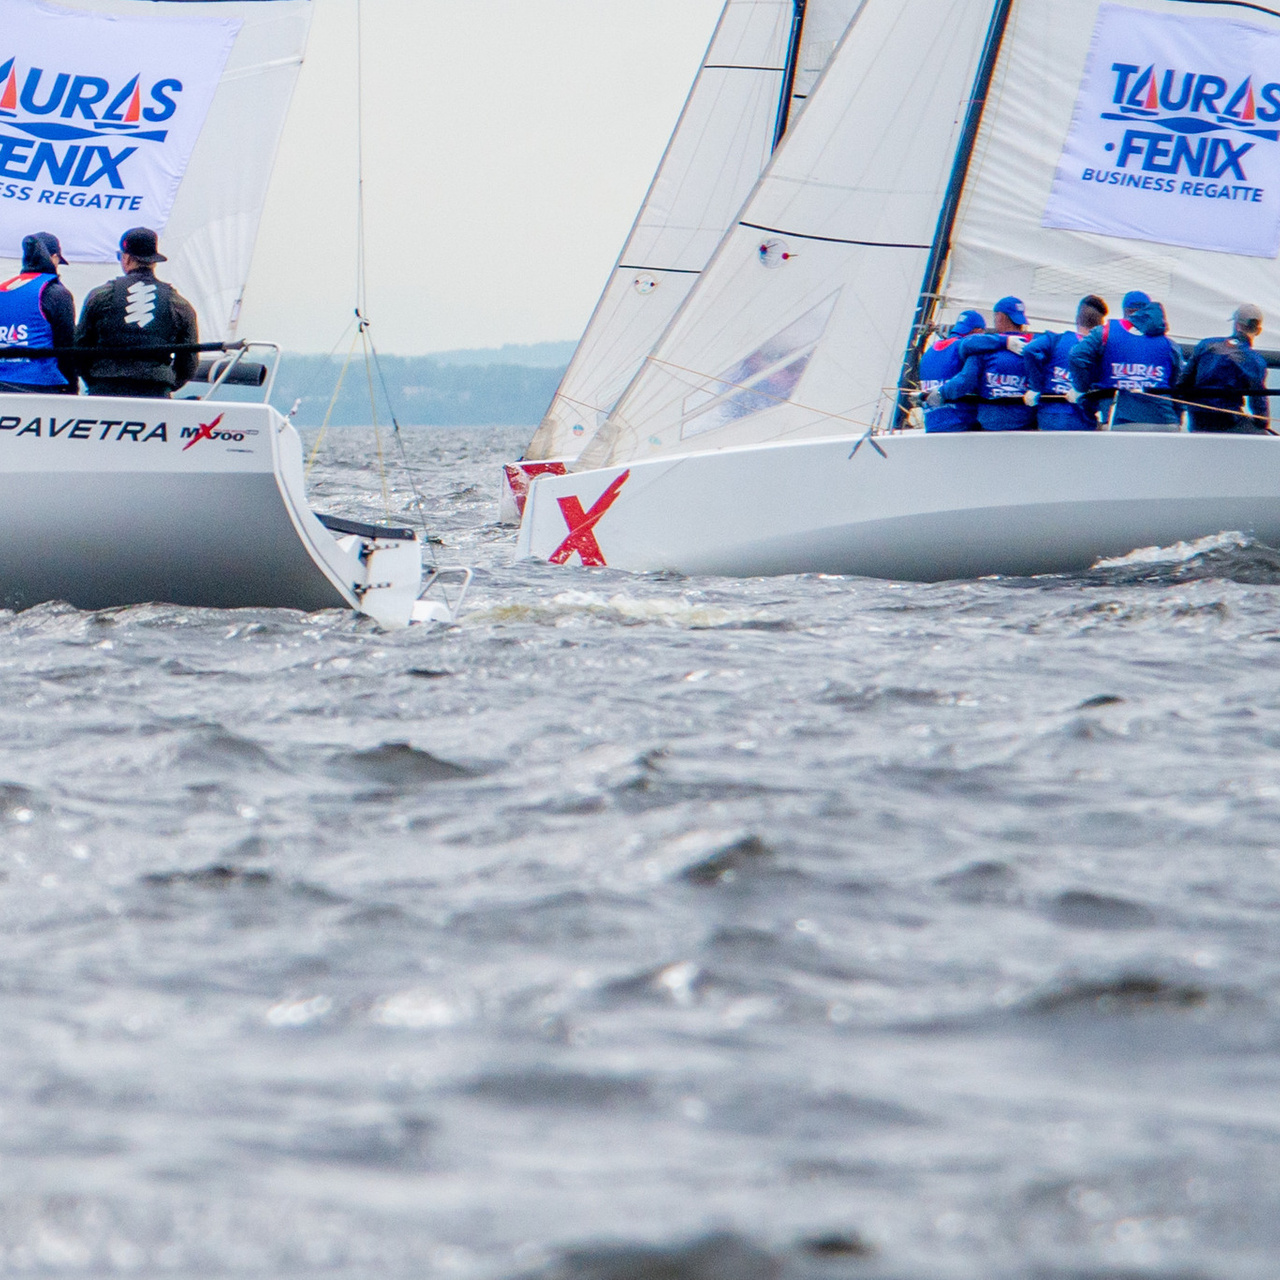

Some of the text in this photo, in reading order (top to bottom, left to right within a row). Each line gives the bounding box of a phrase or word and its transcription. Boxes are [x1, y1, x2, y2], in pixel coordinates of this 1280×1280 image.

[38, 190, 143, 210] REGATTE
[1082, 168, 1264, 203] BUSINESS REGATTE
[180, 412, 244, 451] MX700
